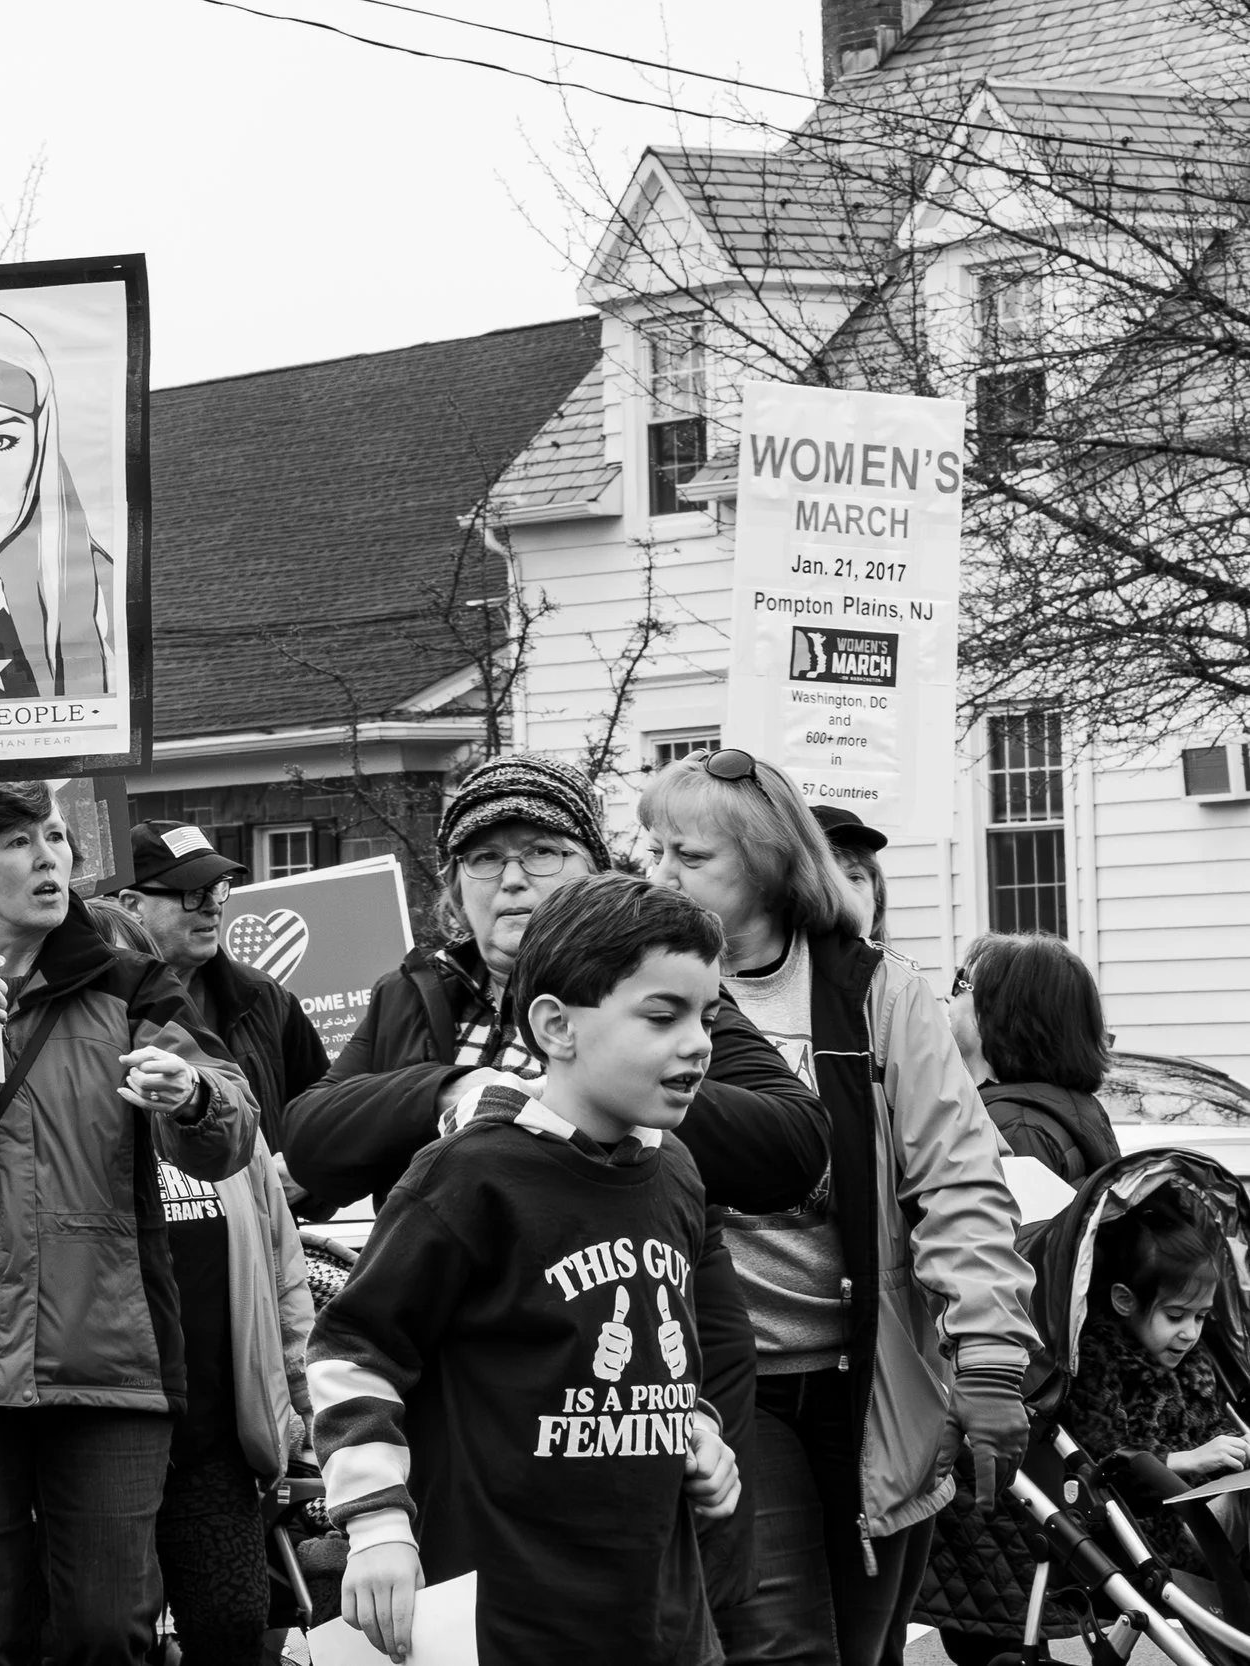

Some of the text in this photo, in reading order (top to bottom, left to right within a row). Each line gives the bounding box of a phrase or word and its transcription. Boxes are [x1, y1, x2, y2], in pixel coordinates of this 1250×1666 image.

[750, 434, 959, 494] WOMEN'S
[795, 500, 909, 539] MARCH
[791, 555, 907, 582] Jan. 21, 2017
[754, 592, 933, 621] Pompton Plains, NJ
[836, 637, 889, 655] WOMEN'S
[831, 652, 892, 677] MARCH
[791, 690, 888, 709] Washington, DC
[829, 714, 851, 726] and
[34, 735, 72, 746] FEAR
[806, 731, 868, 747] 600+ more
[831, 752, 842, 765] in
[803, 782, 879, 800] 57 Countries
[300, 989, 372, 1014] OME HE
[163, 1199, 218, 1222] ERAN'S
[544, 1237, 690, 1302] THIS GUY
[562, 1383, 696, 1413] IS A PROUD
[533, 1411, 694, 1457] FEMINIS
